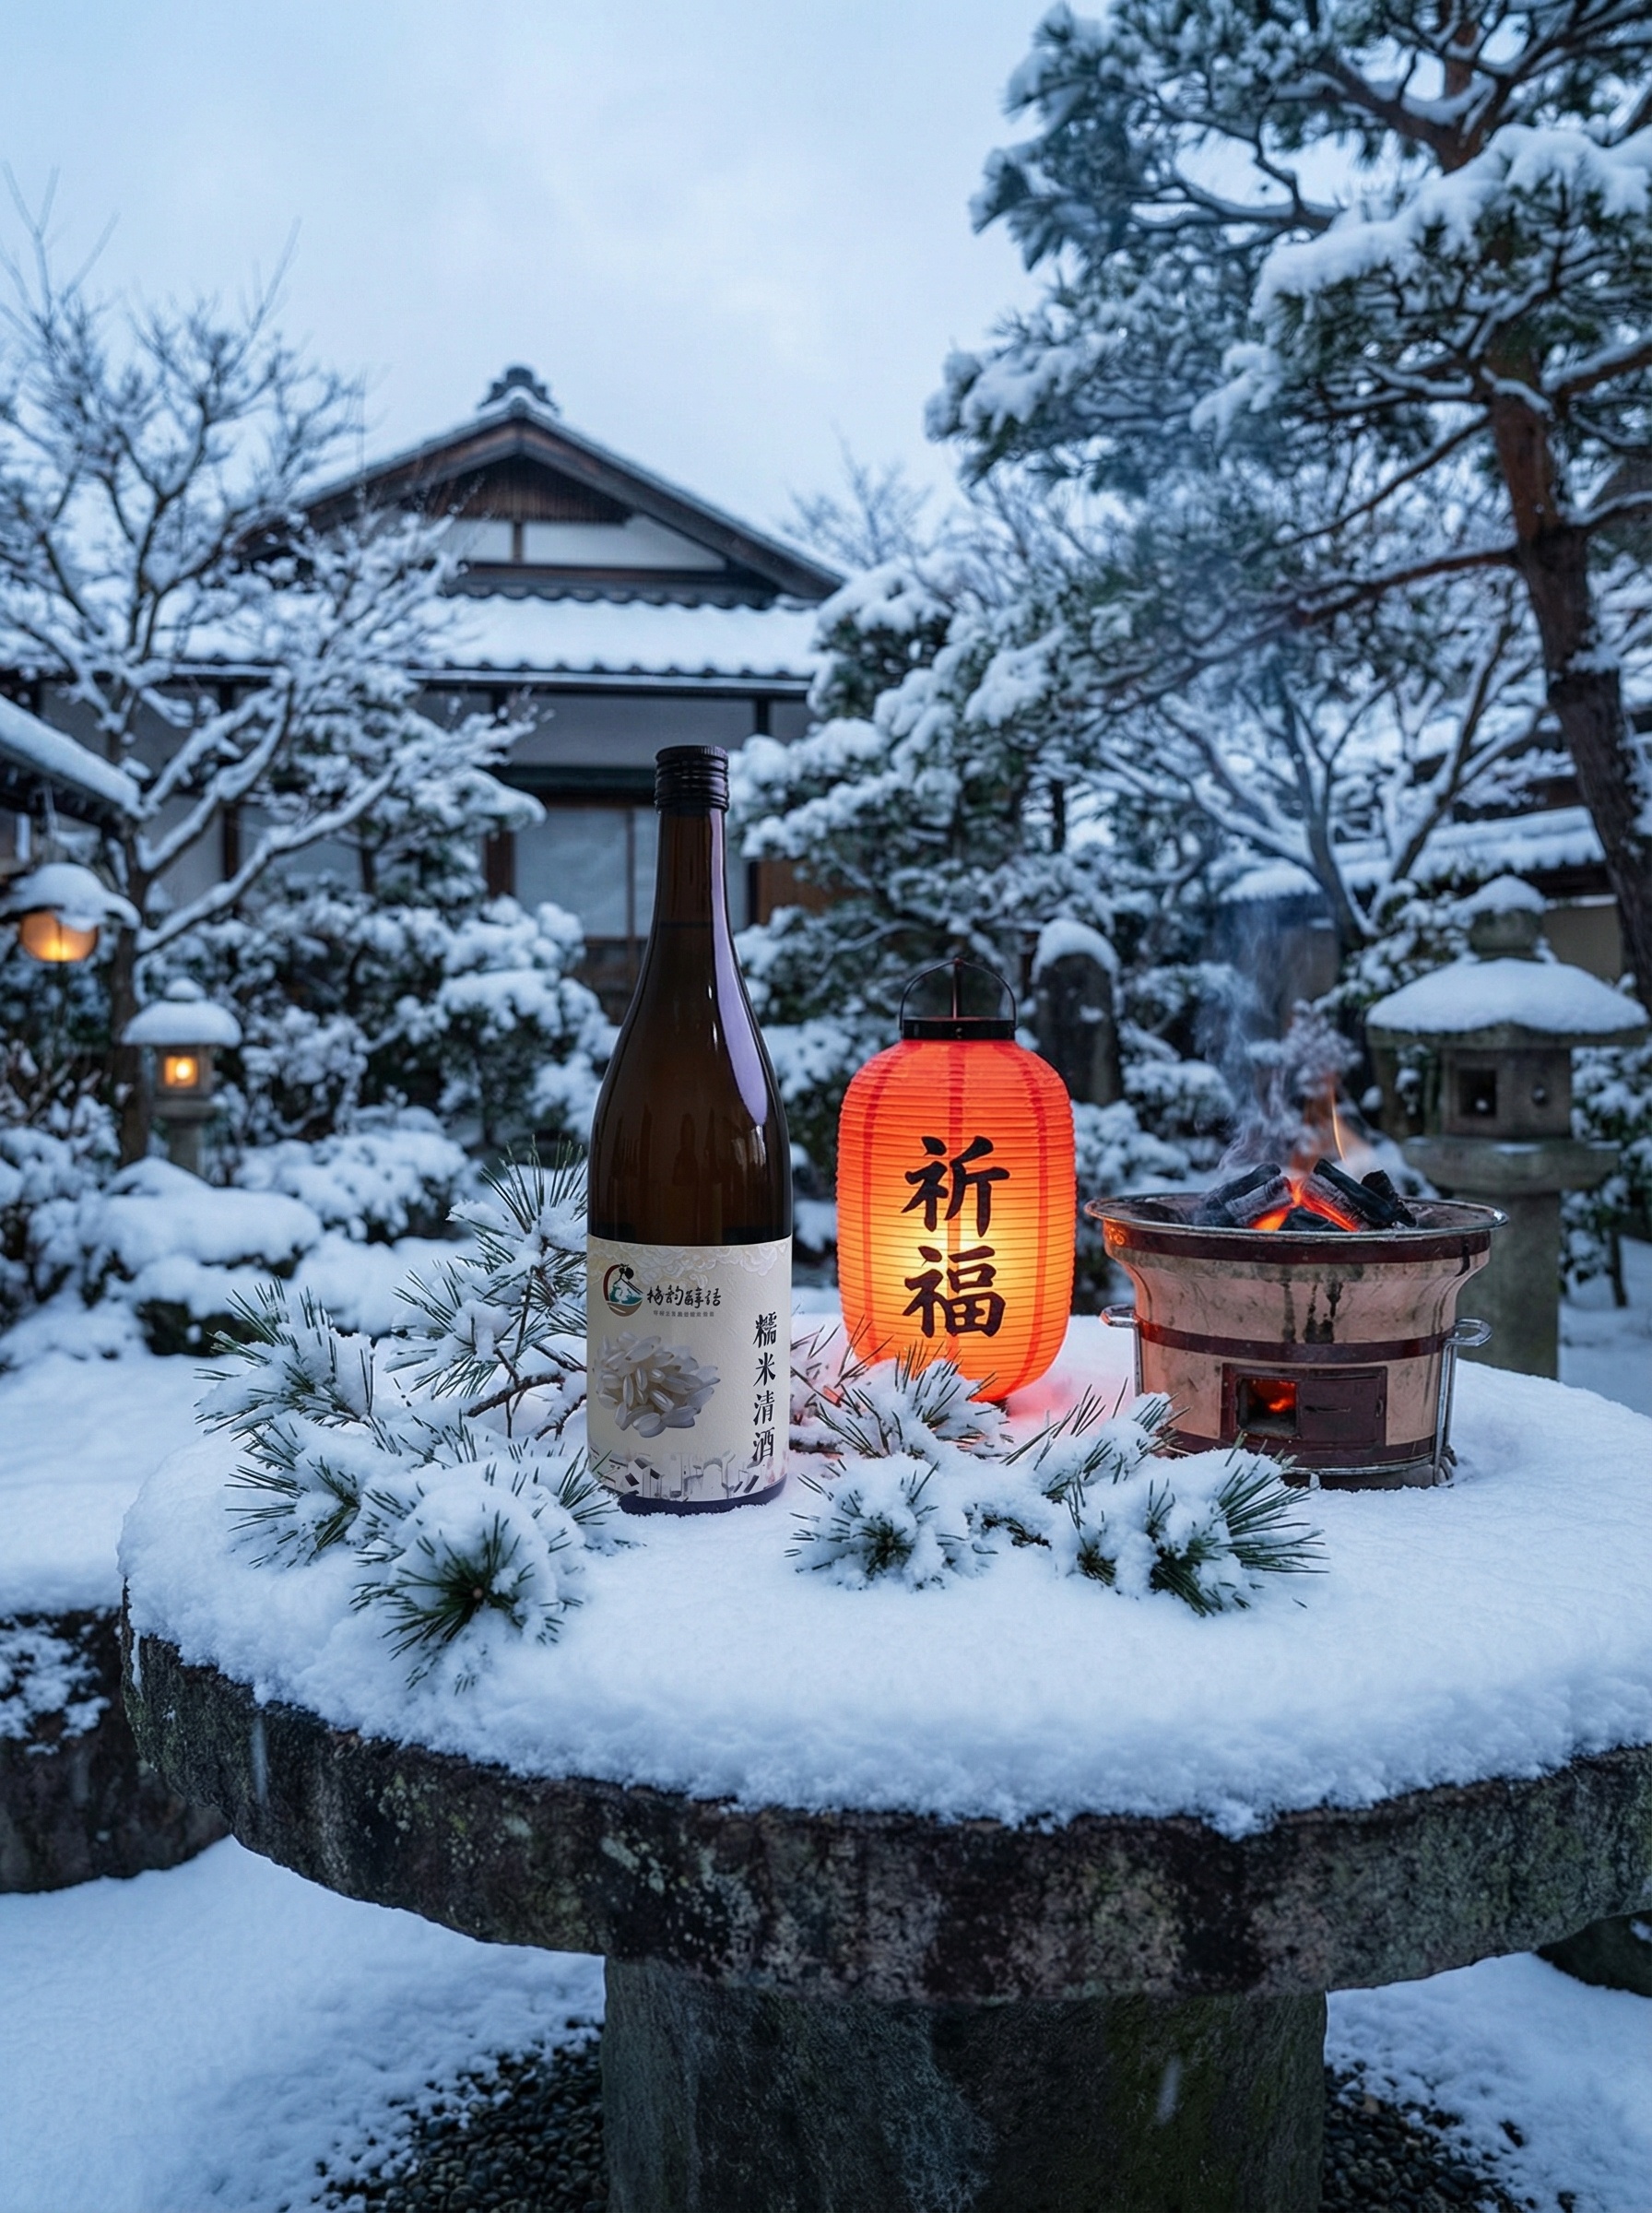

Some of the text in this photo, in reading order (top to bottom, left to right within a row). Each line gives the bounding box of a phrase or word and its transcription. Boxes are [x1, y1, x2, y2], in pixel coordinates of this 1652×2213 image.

[902, 1135, 1010, 1339] 祈福
[751, 1311, 777, 1462] 糯米清酒
